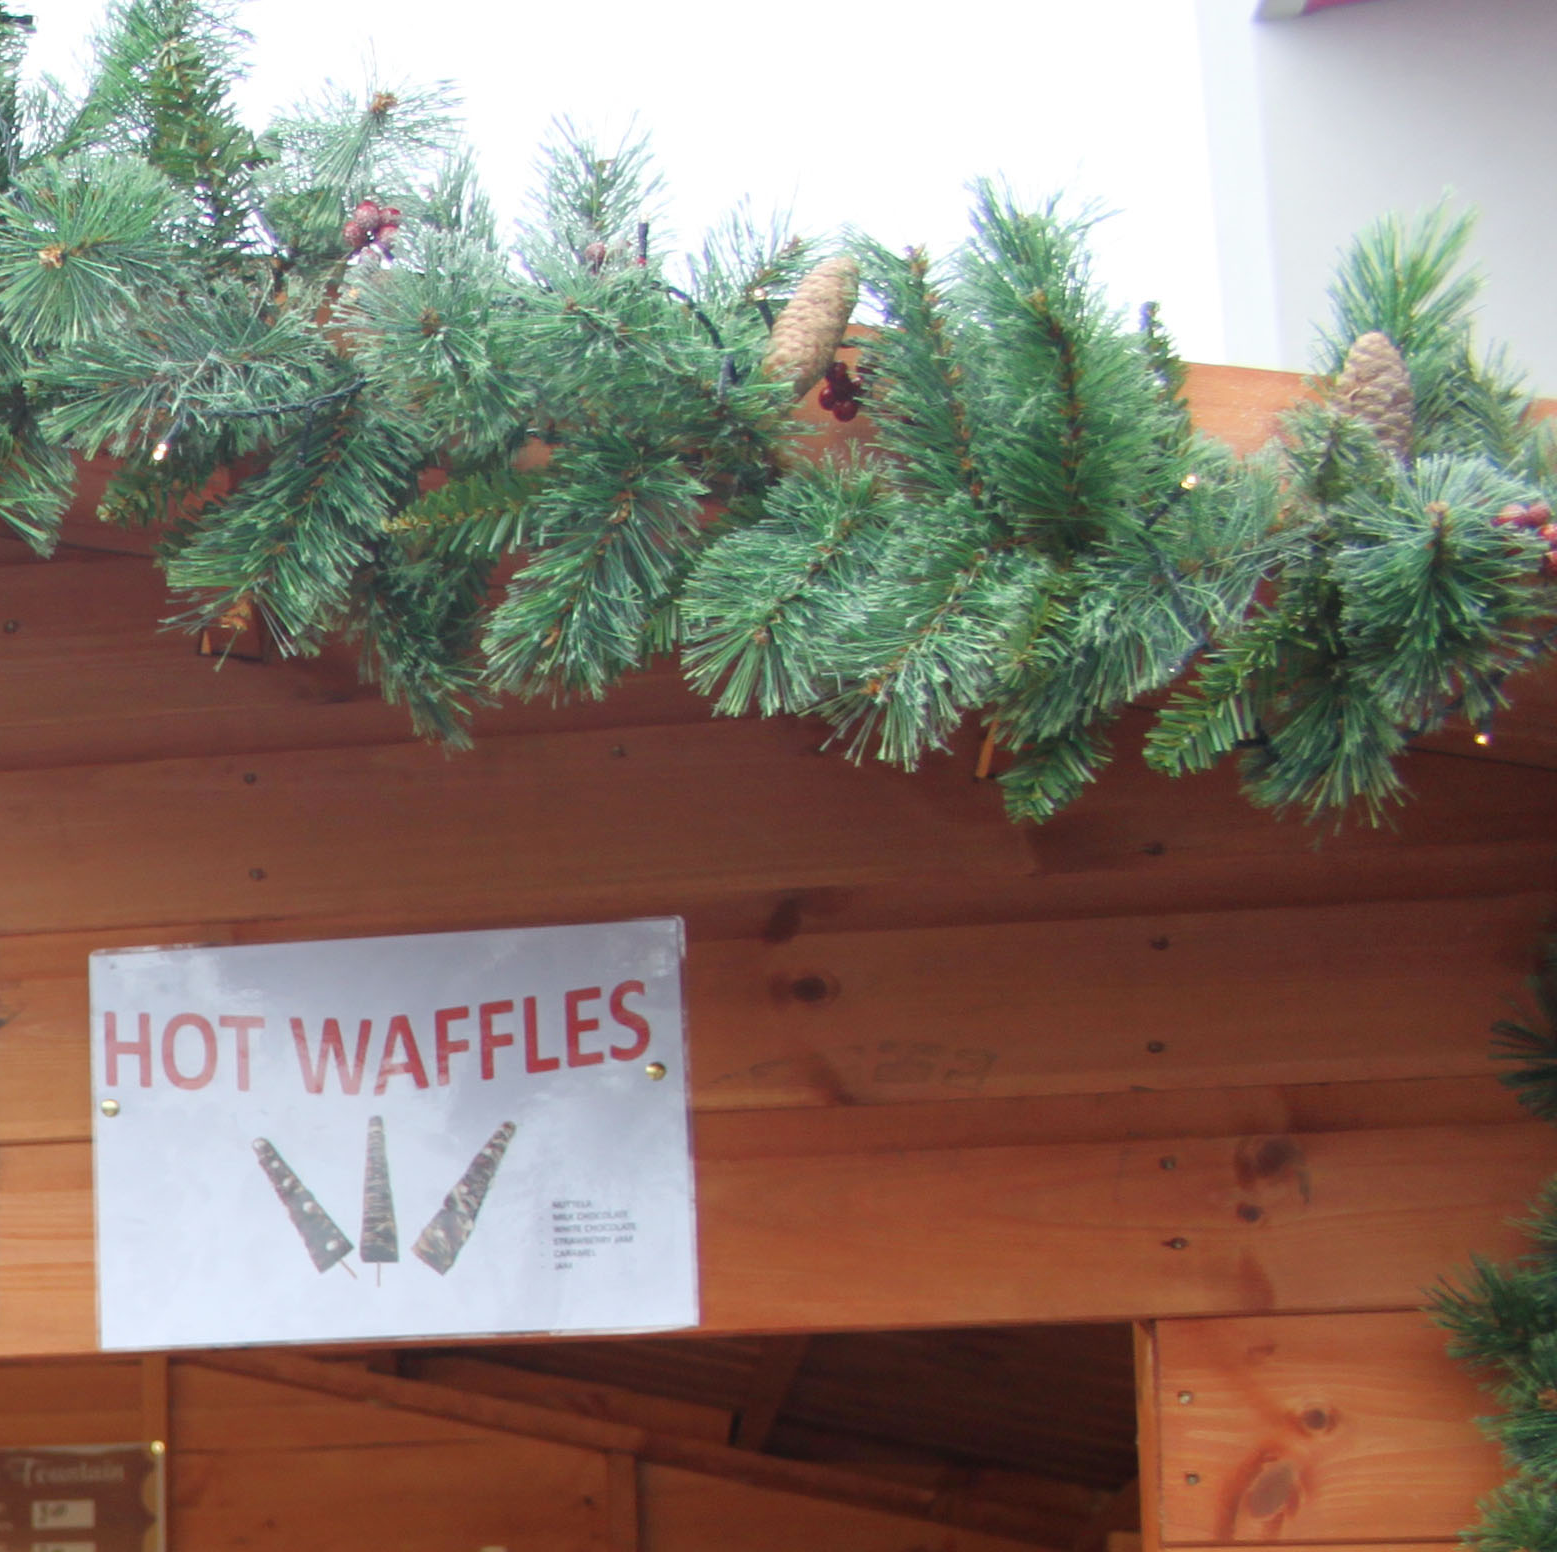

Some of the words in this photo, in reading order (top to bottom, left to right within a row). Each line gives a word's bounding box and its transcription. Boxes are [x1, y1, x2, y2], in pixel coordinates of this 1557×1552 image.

[102, 1011, 265, 1092] HOT
[289, 979, 651, 1097] WAFFLES
[584, 1222, 636, 1232] CHOCOLATE
